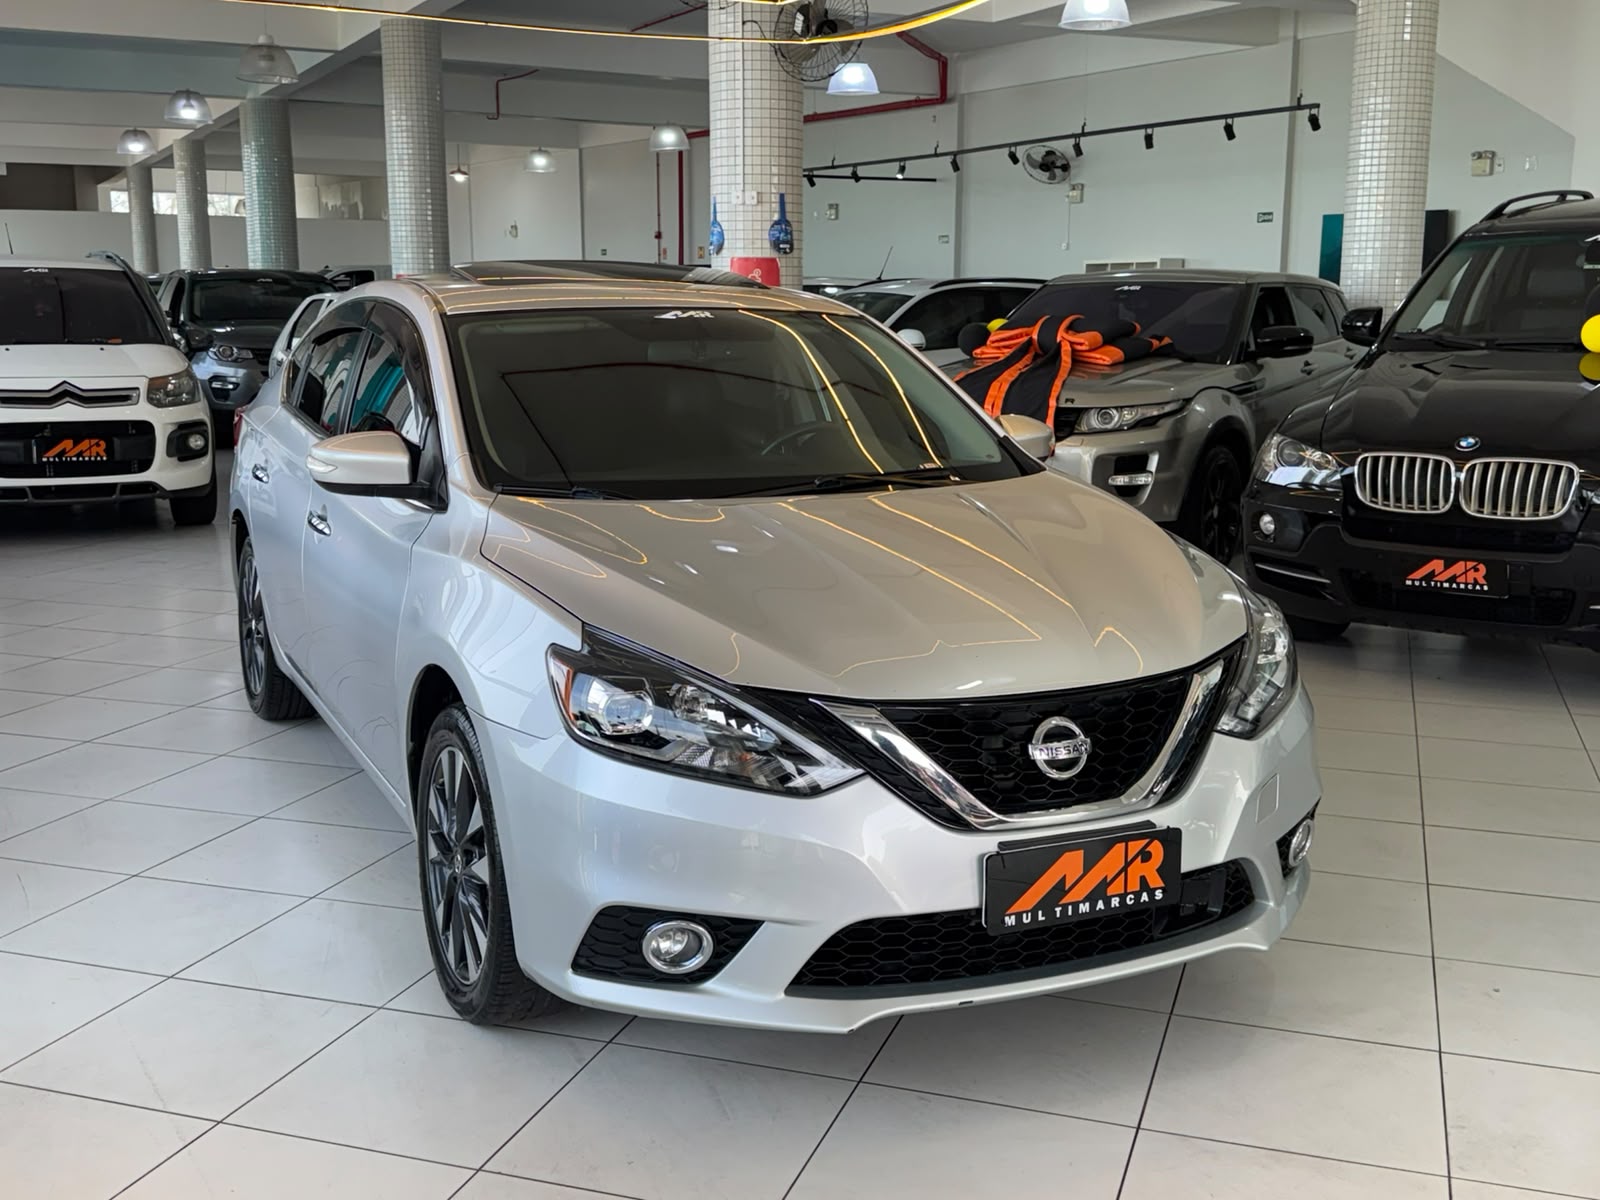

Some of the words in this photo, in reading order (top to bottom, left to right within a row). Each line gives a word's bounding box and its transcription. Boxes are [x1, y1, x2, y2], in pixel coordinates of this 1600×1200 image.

[1405, 580, 1488, 591] MULTIMARCAS
[1038, 740, 1088, 758] NISSAN
[1004, 889, 1165, 928] MULTIMARCAS
